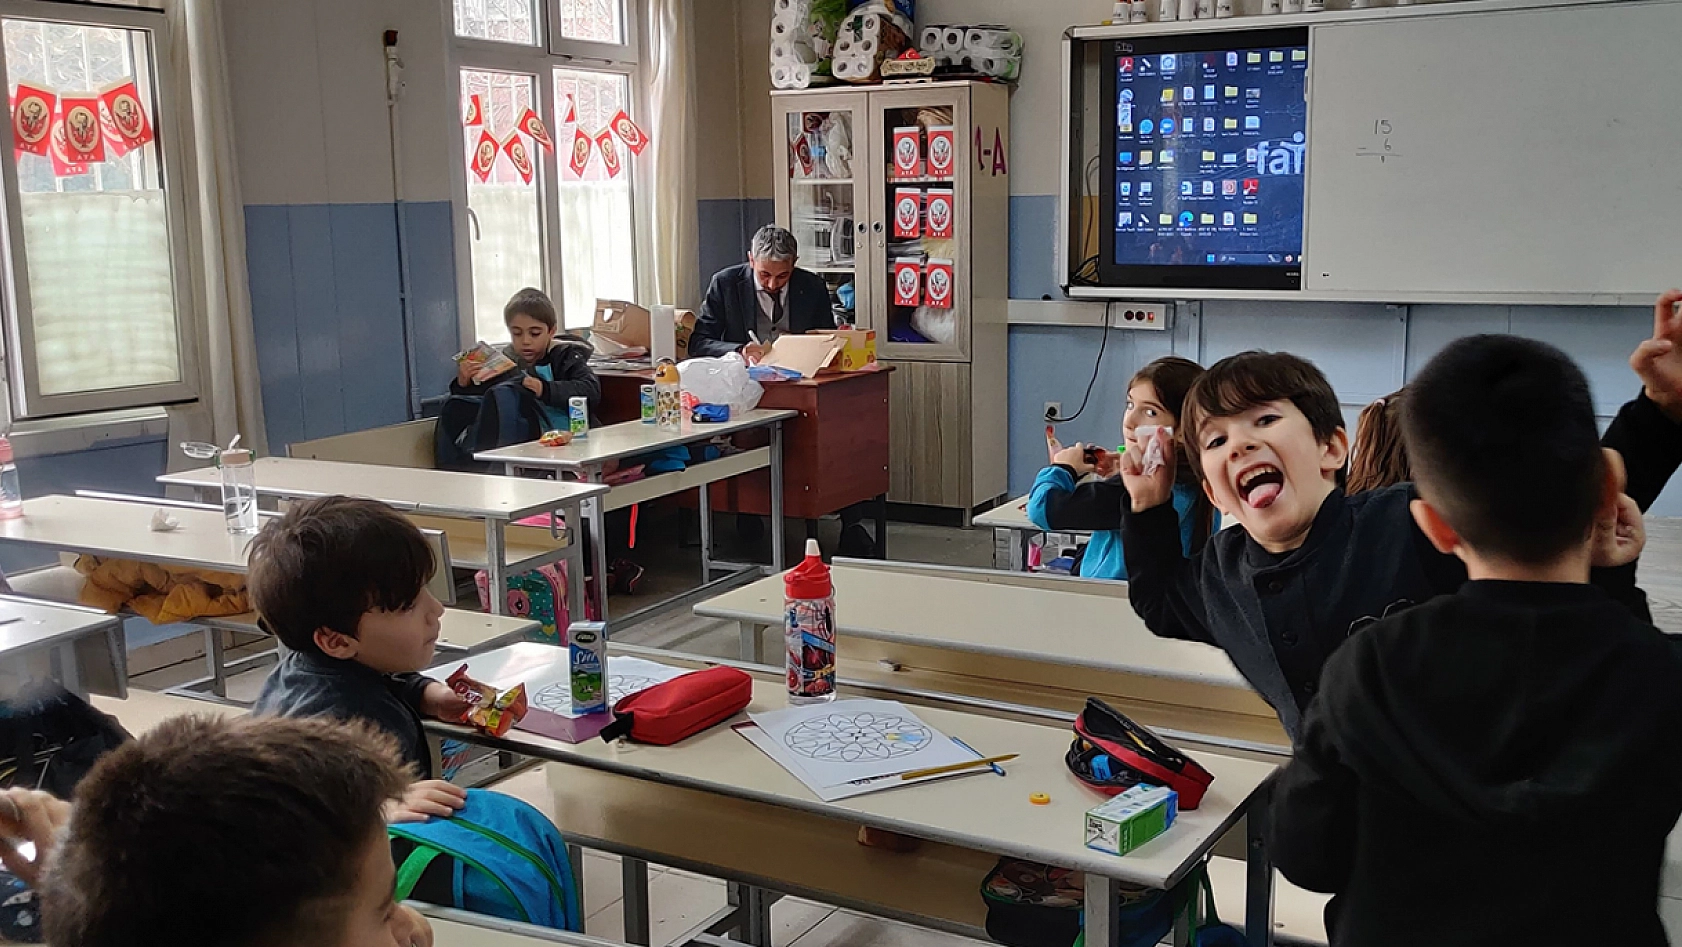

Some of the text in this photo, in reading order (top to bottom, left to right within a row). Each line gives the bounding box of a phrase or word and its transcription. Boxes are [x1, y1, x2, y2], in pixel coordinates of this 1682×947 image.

[1374, 119, 1393, 135] 15
[975, 125, 1007, 177] 1-A
[1384, 137, 1393, 151] 6
